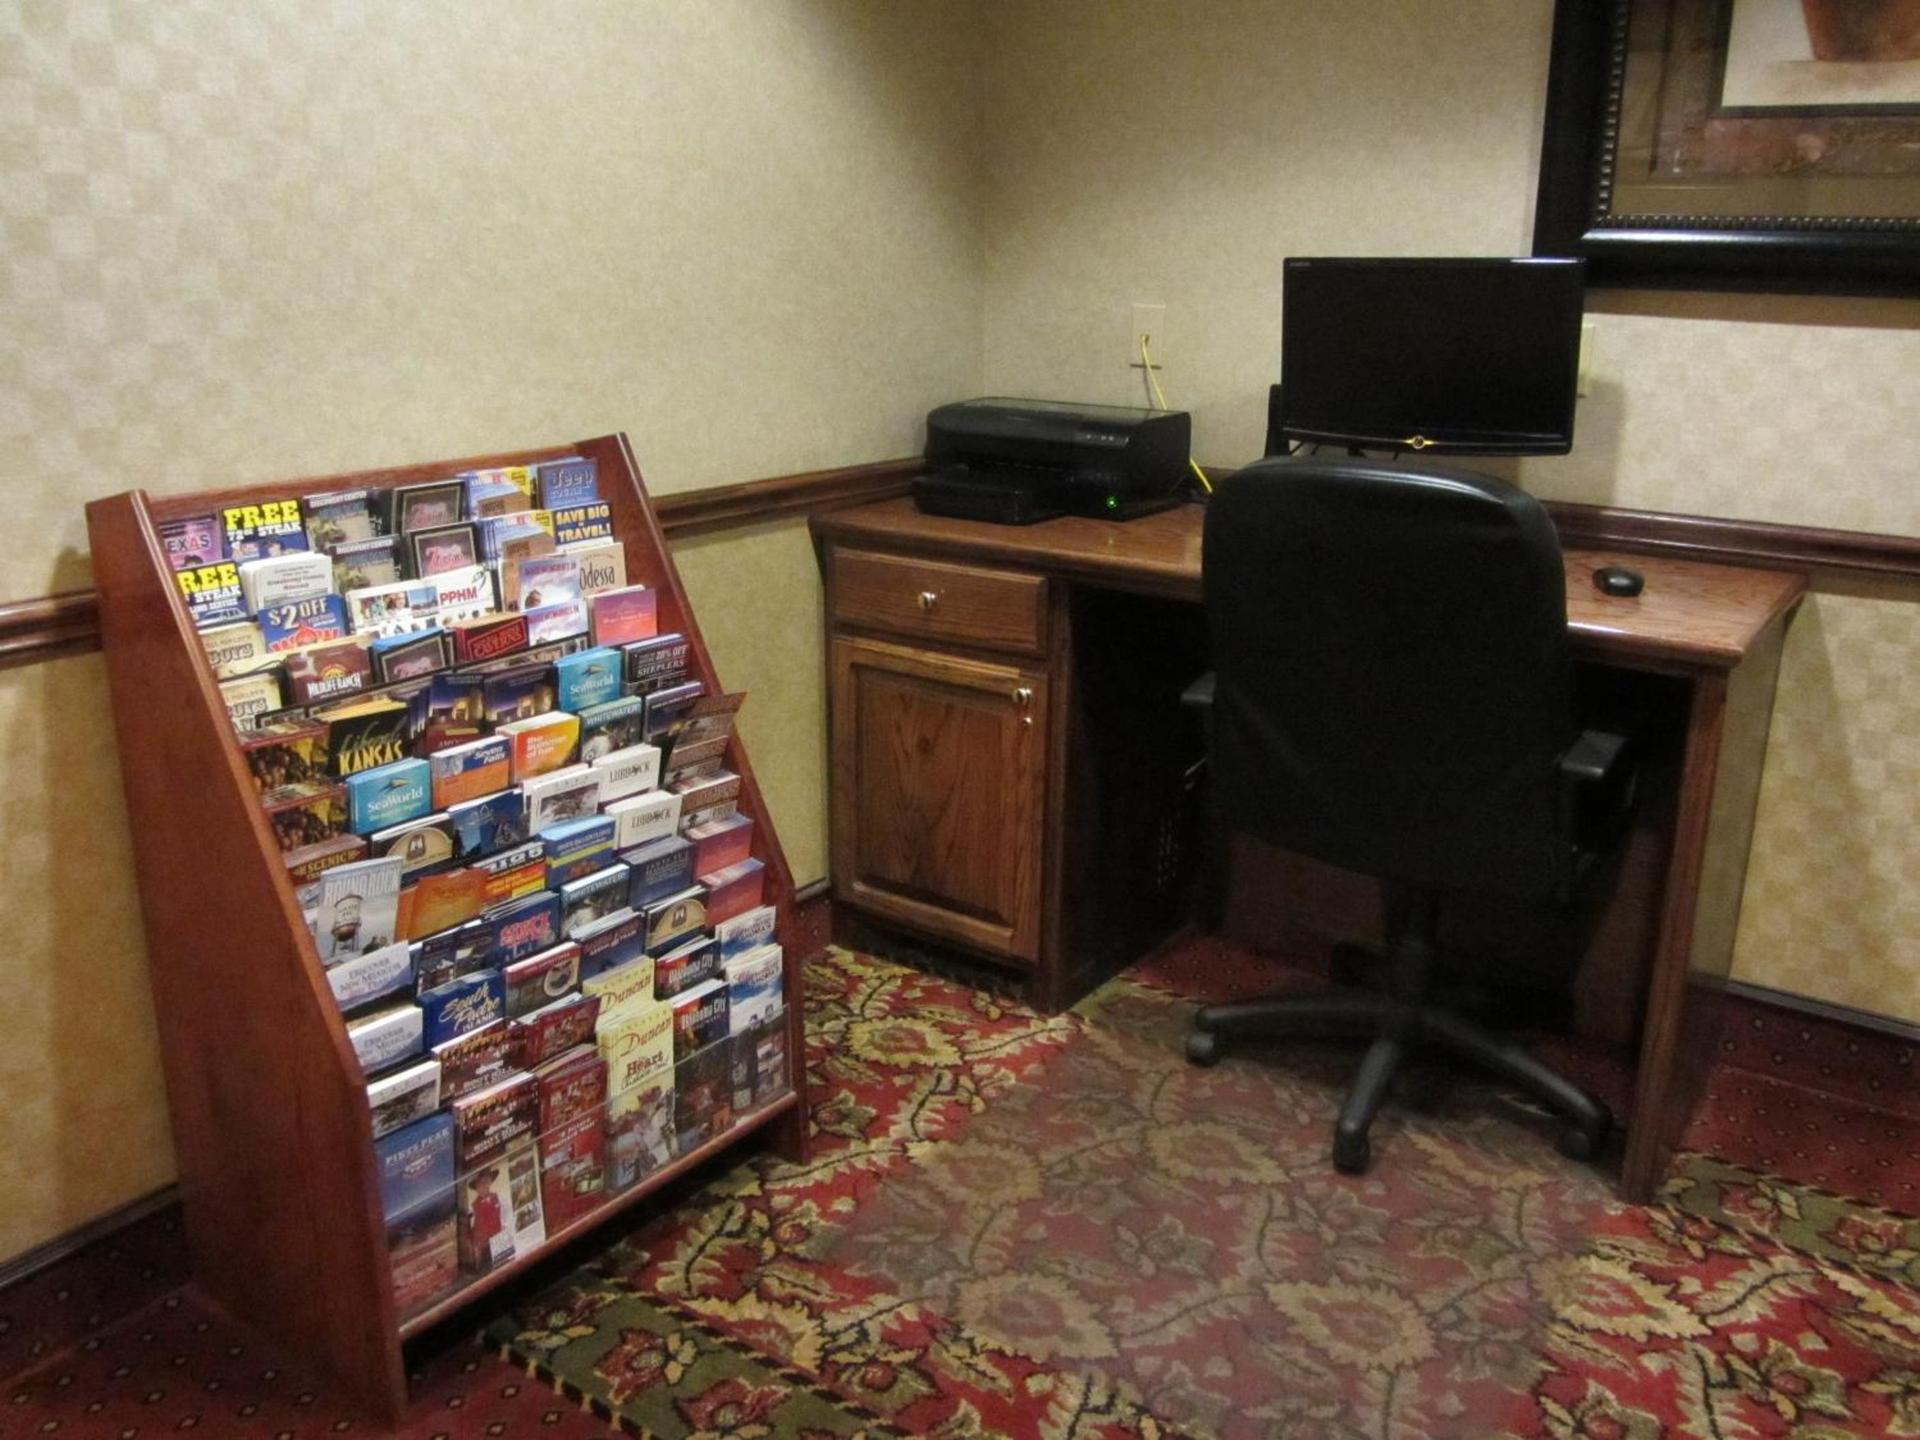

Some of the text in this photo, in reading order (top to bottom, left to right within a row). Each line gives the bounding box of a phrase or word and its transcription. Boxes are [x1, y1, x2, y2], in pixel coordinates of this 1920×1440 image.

[223, 500, 300, 530] FREE
[557, 508, 584, 525] SAVE
[587, 503, 609, 519] BIG
[258, 521, 302, 537] STEAK
[558, 523, 611, 542] TRAVEL!
[166, 534, 210, 550] EXAS
[176, 562, 240, 593] REE
[579, 560, 615, 591] Odessa
[195, 584, 242, 602] STEAK
[439, 585, 478, 605] PPHM
[268, 604, 297, 630] $2
[300, 597, 328, 617] OFF
[569, 674, 614, 696] SeaWorld
[338, 739, 403, 776] KANSAS
[367, 786, 424, 813] SeaWorld
[307, 852, 349, 872] SCENIC
[626, 1050, 664, 1076] Heart
